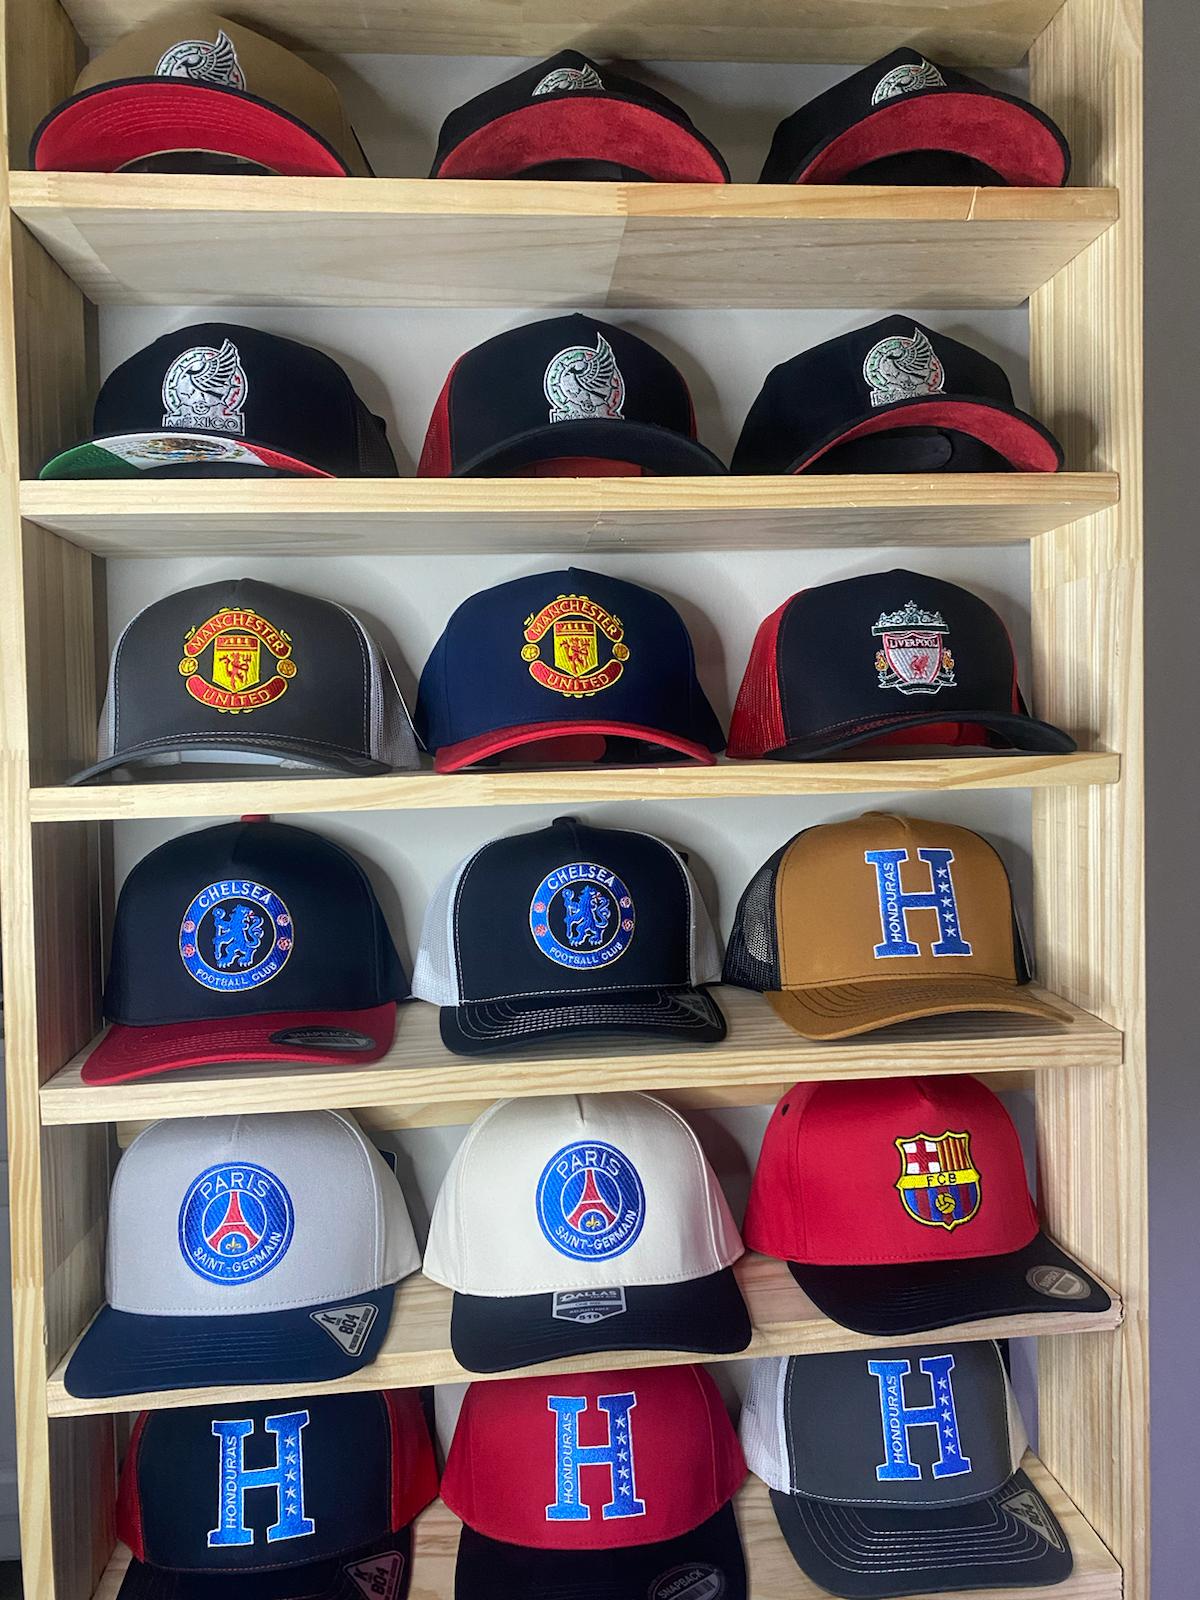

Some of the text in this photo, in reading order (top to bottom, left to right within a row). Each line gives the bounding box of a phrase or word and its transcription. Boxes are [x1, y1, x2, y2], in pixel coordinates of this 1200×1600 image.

[531, 600, 618, 636] MANCHESTER
[191, 613, 284, 652] MANCHESTER
[889, 639, 939, 649] LIVERPOOL
[547, 674, 609, 691] UNITED
[203, 689, 271, 706] UNITED
[547, 865, 616, 890] CHELSEA
[199, 882, 273, 908] CHELSEA
[883, 862, 903, 943] HONDURAS
[549, 942, 623, 965] FOOTBALL CLUB
[195, 961, 278, 987] FOOTBALL CLUB
[556, 1150, 622, 1179] PARIS
[200, 1172, 270, 1200] PARIS
[926, 1173, 957, 1187] FCB
[555, 1209, 637, 1250] SAINT-GERMAIN
[193, 1231, 283, 1273] SAINT-GERMAIN
[560, 1290, 617, 1302] DALLAS
[339, 1313, 360, 1335] 804
[886, 1375, 904, 1464] HONDURAS
[562, 1412, 574, 1504] HONDURAS
[225, 1435, 237, 1529] HONDURAS
